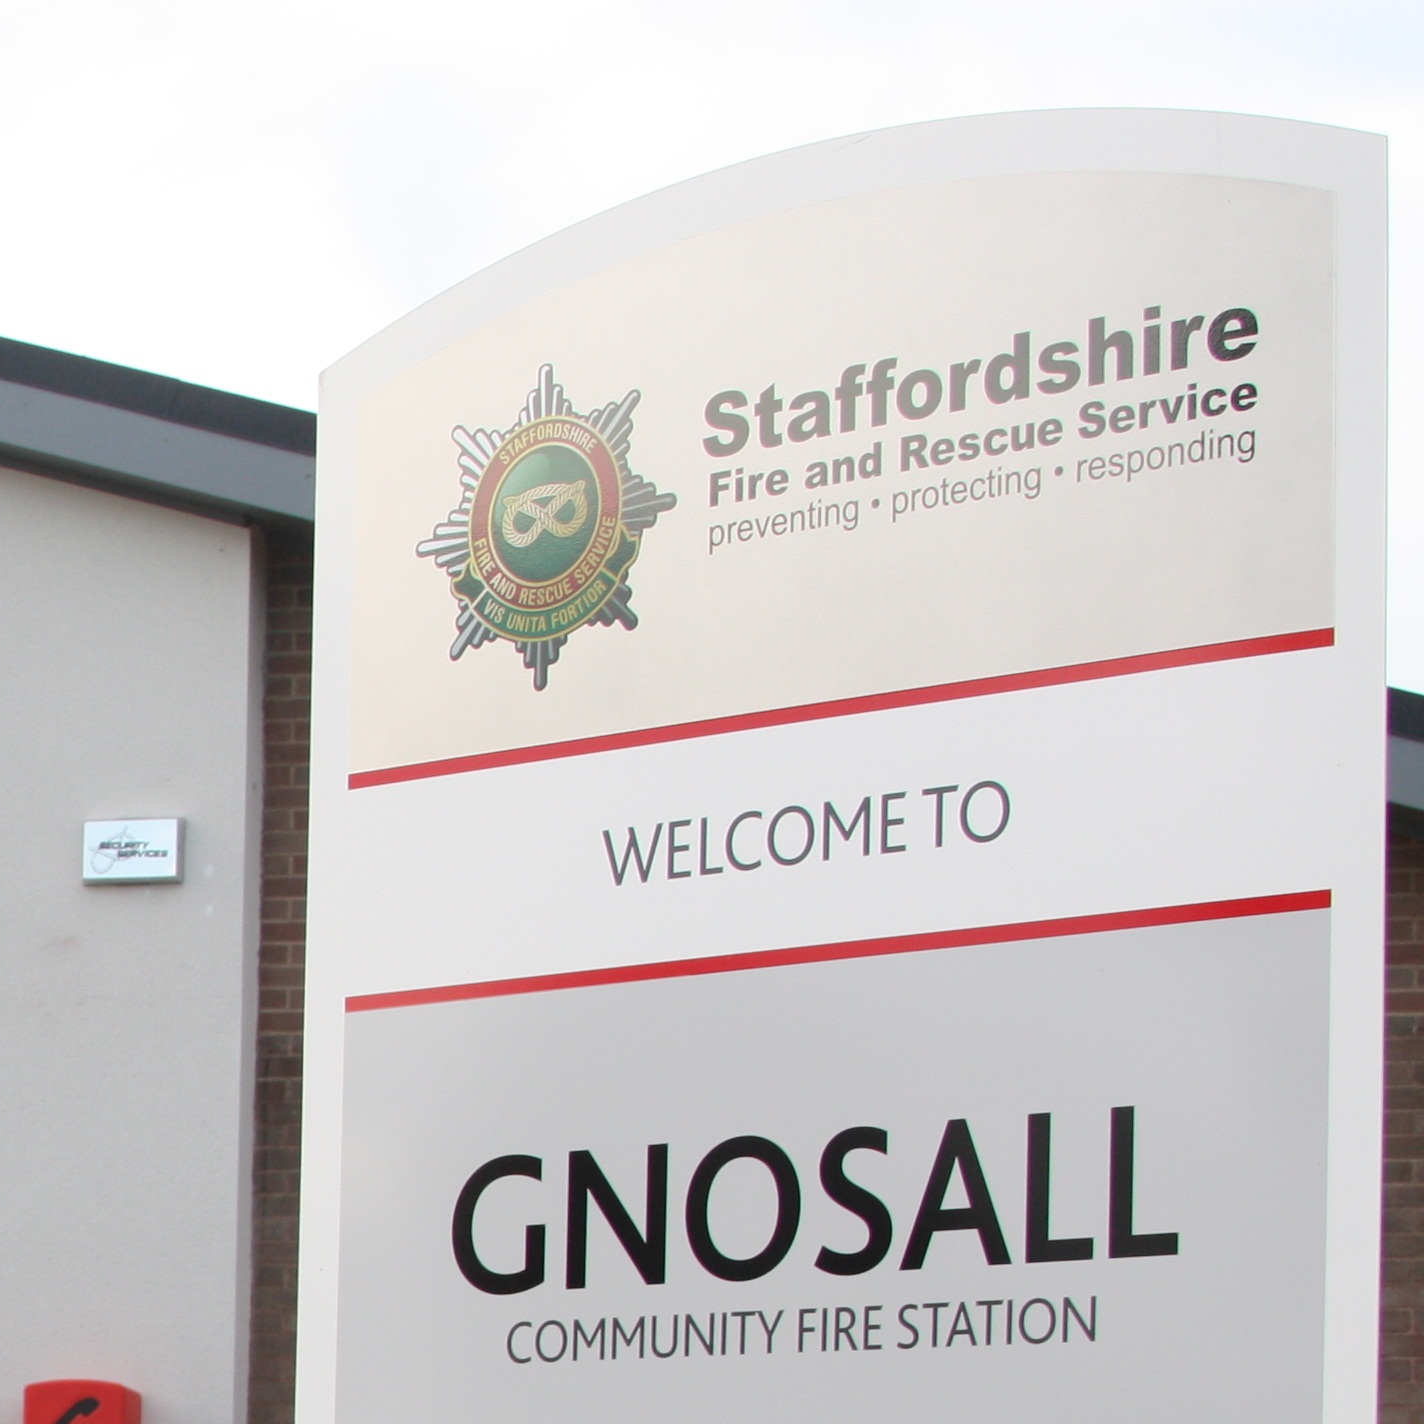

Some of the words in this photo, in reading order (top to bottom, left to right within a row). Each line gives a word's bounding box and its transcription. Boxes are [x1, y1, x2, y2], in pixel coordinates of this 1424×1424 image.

[701, 305, 1259, 458] Staffordshire
[499, 423, 598, 465] STAFFORDSHIRE
[709, 468, 789, 508] Fire
[804, 442, 882, 490] and
[900, 418, 1063, 474] Rescue
[1078, 382, 1258, 439] Service
[709, 497, 859, 555] preventing
[892, 465, 1042, 522] protecting
[1077, 429, 1256, 483] responding
[474, 537, 491, 577] FIRE
[490, 572, 517, 600] AND
[518, 576, 574, 606] RESCUE
[575, 516, 616, 584] SERVICE
[483, 598, 504, 625] VIS
[506, 612, 546, 633] UNITA
[551, 579, 607, 629] FORTIOR
[98, 841, 150, 850] SECURITY
[117, 849, 169, 858] SERVICES
[602, 791, 907, 886] WELCOME
[921, 780, 1011, 849] TO
[452, 1105, 1180, 1296] GNOSALL
[506, 1309, 784, 1365] COMMUNITY
[797, 1304, 883, 1352] FIRE
[896, 1295, 1098, 1350] STATION
